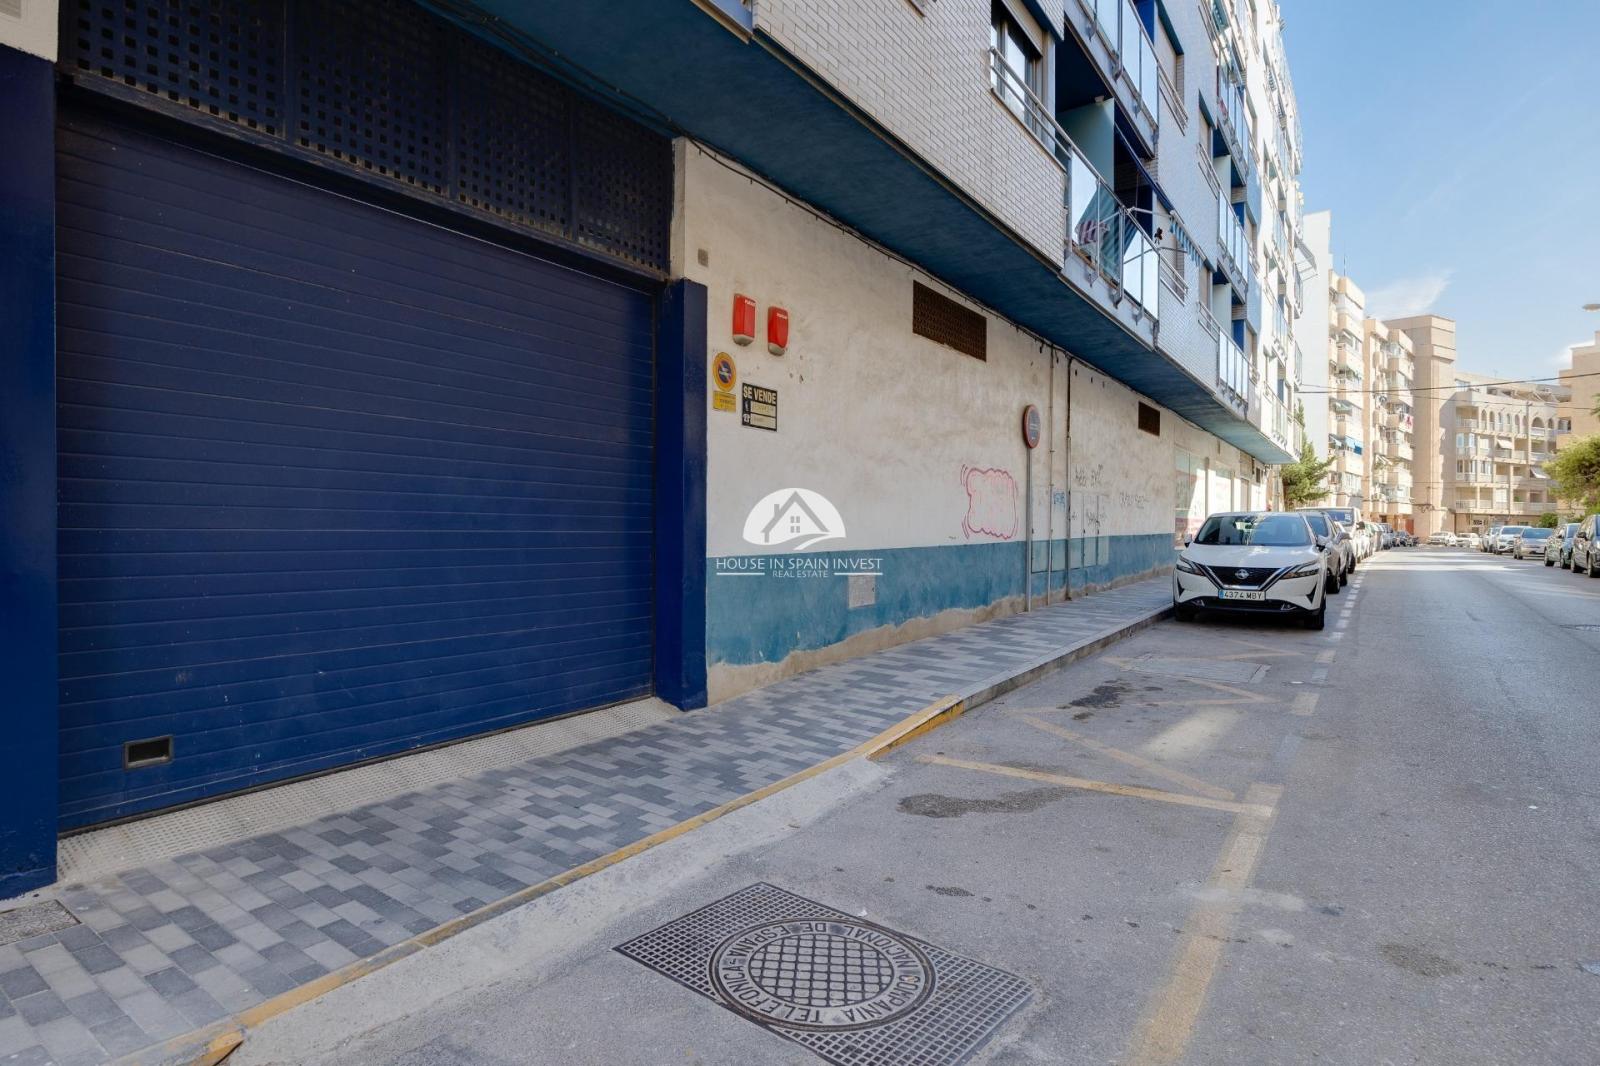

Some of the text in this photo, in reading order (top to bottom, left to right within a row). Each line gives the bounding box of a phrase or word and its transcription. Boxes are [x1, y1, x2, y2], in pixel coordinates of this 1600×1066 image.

[743, 386, 752, 399] SE
[753, 387, 776, 404] VENDE
[800, 923, 826, 932] DE
[844, 925, 919, 968] NACIONAL
[722, 965, 823, 1023] TELEFONICA
